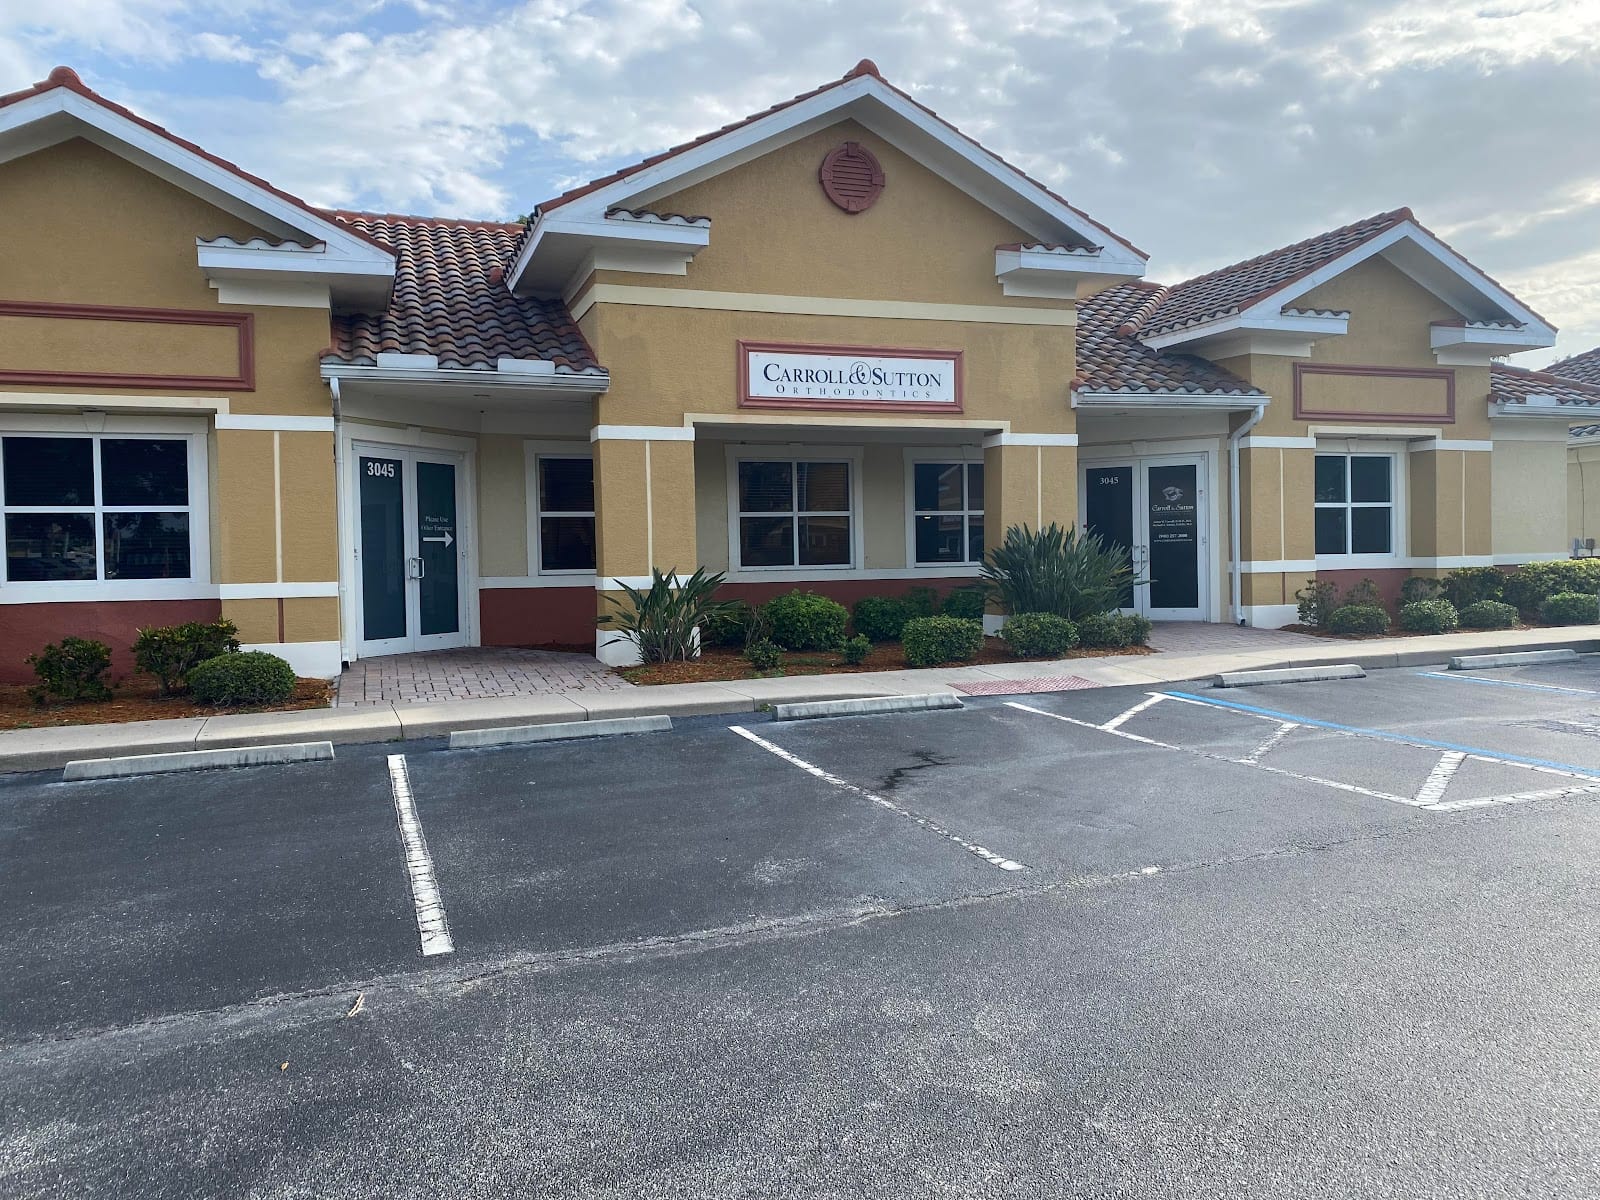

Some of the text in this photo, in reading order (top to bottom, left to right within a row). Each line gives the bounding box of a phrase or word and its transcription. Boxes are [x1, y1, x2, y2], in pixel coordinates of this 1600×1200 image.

[763, 361, 942, 387] CARROLL & SUTTON
[776, 385, 931, 398] ORTHODONTICS
[367, 462, 395, 477] 3045
[1099, 476, 1119, 485] 3045
